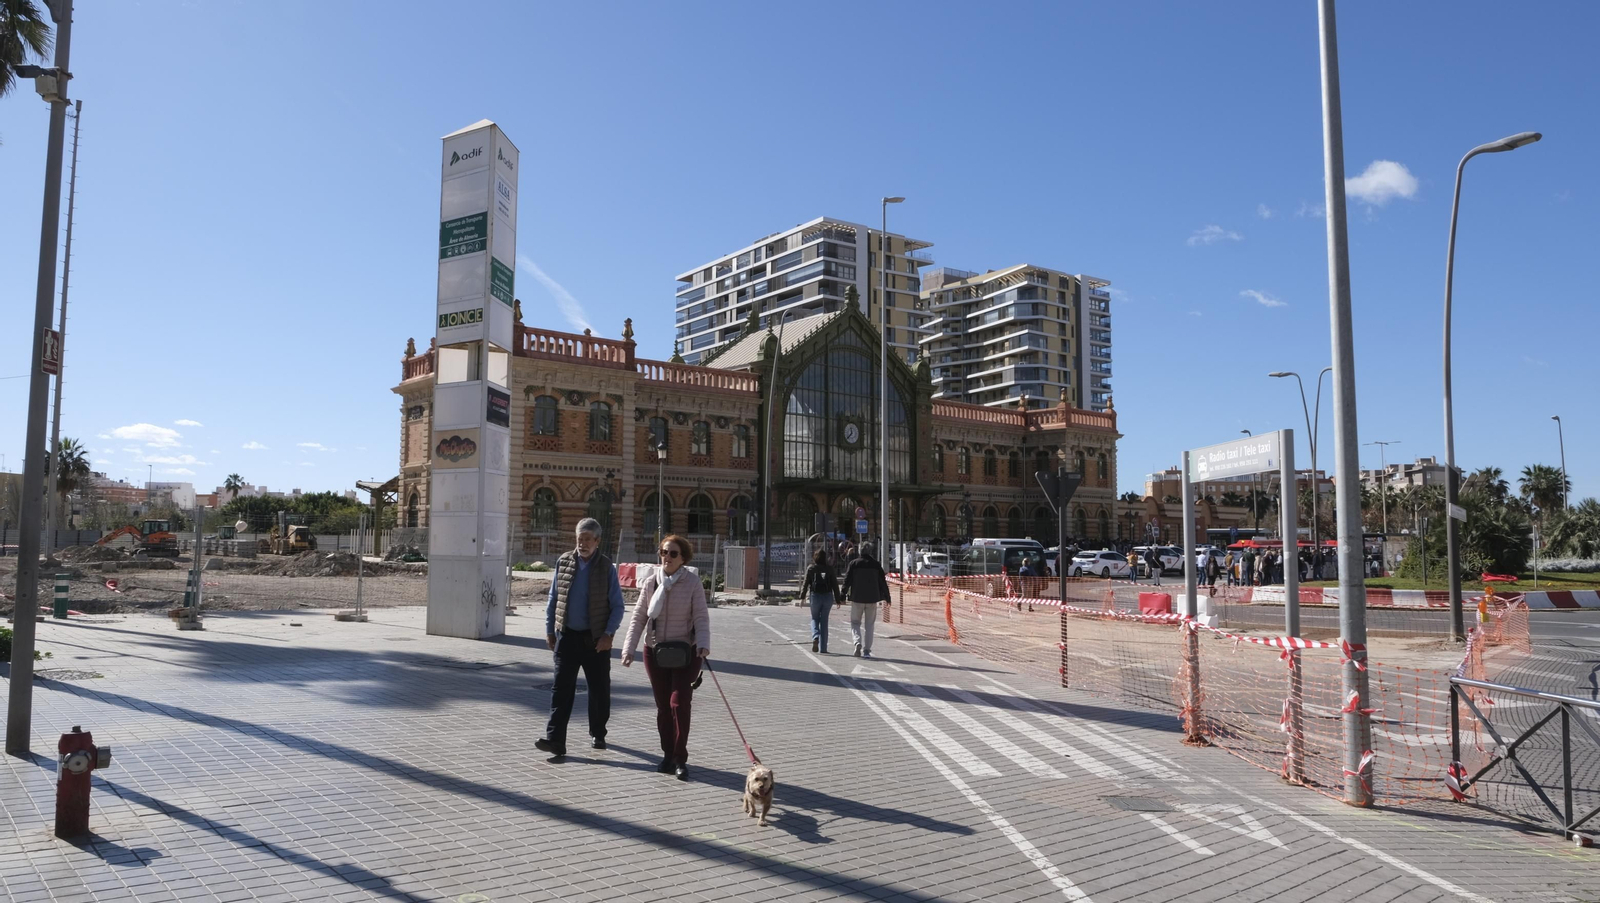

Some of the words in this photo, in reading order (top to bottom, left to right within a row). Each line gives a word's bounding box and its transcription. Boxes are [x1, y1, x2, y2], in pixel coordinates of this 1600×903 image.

[461, 146, 483, 160] adif
[449, 309, 483, 325] ONCE
[1209, 450, 1226, 462] Radio
[1227, 447, 1238, 460] taxi
[1244, 444, 1256, 456] Tele
[1258, 441, 1271, 454] taxi
